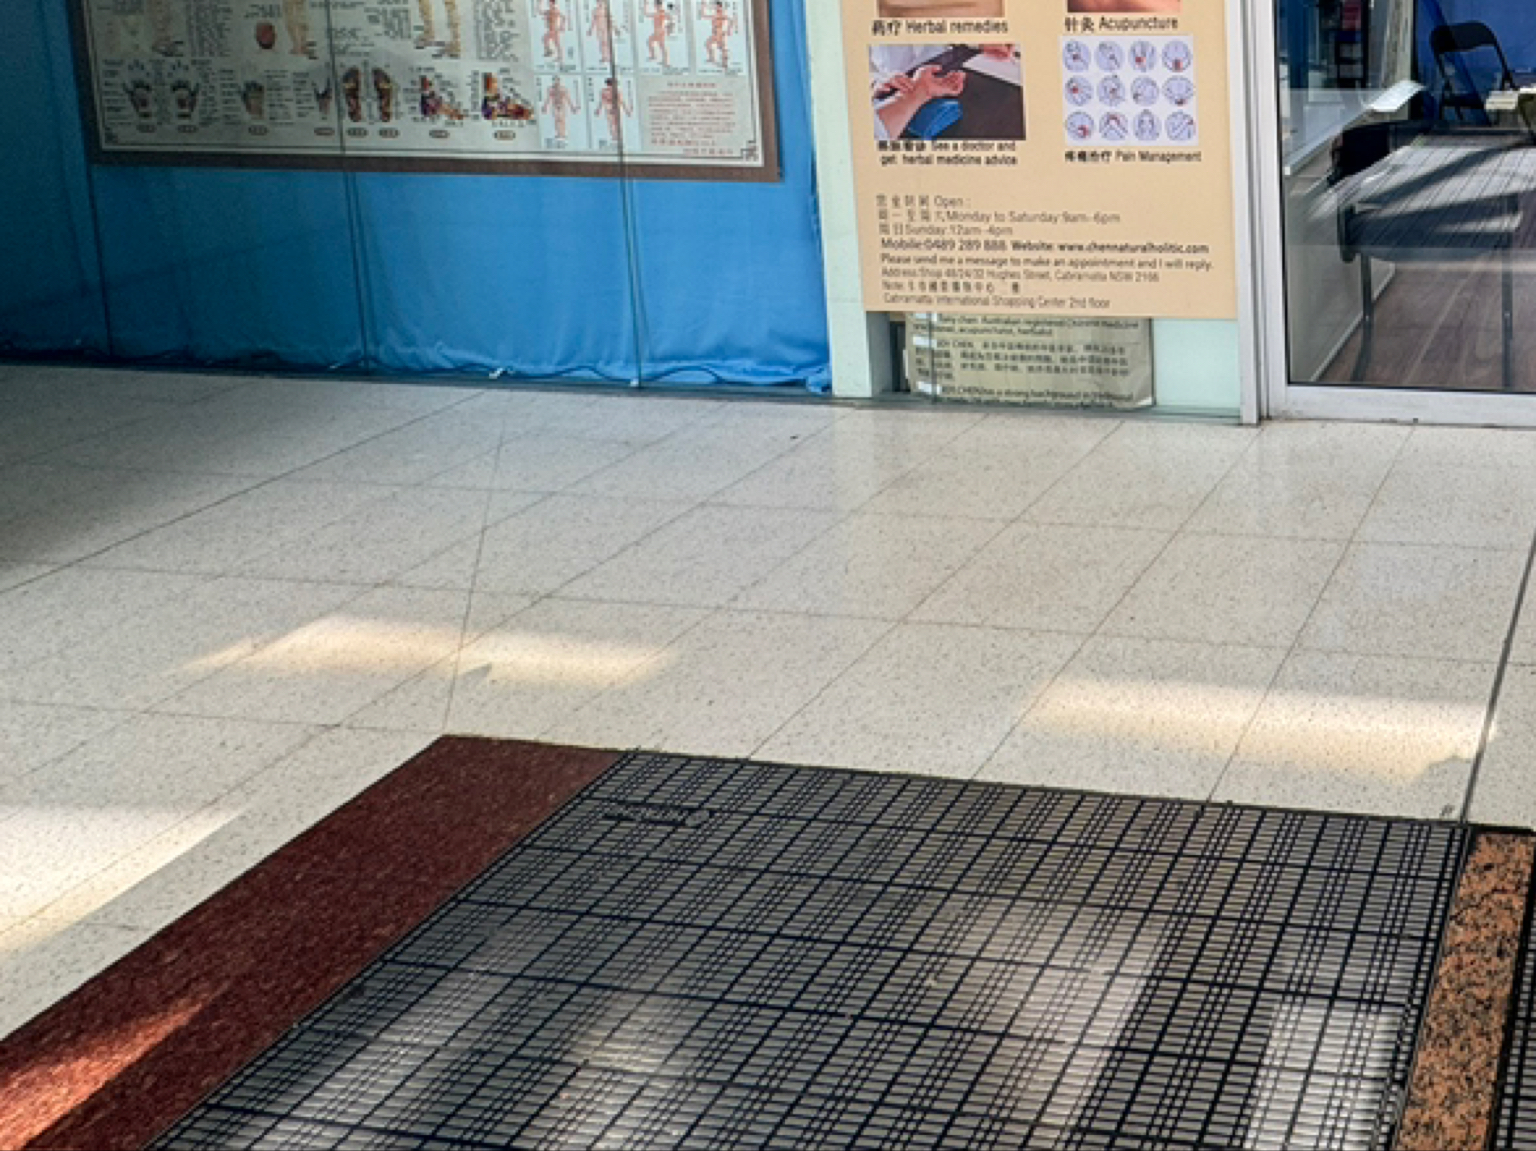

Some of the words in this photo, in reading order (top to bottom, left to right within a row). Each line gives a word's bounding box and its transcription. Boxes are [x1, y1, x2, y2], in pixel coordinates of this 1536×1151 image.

[905, 20, 947, 33] Herbal
[951, 20, 1008, 33] remedies
[1099, 16, 1178, 31] Acupuncture
[961, 140, 994, 151] doctor
[997, 140, 1016, 151] and
[902, 154, 934, 165] herbal
[937, 155, 981, 165] medicine
[984, 155, 1017, 165] advice
[1116, 151, 1135, 162] Pain
[1138, 151, 1202, 164] Management
[933, 195, 963, 208] Open
[946, 210, 991, 224] Monday
[994, 211, 1005, 222] to
[1009, 211, 1058, 224] Saturday
[880, 253, 911, 264] Please
[914, 254, 937, 264] send
[966, 257, 1008, 268] message
[1023, 256, 1050, 266] make
[1069, 257, 1135, 269] appointment
[1138, 258, 1157, 269] and
[1109, 271, 1133, 282] NSW
[992, 295, 1034, 308] Shopping
[1037, 296, 1066, 307] Center
[1069, 297, 1087, 308] 2nd
[1088, 297, 1110, 308] floor
